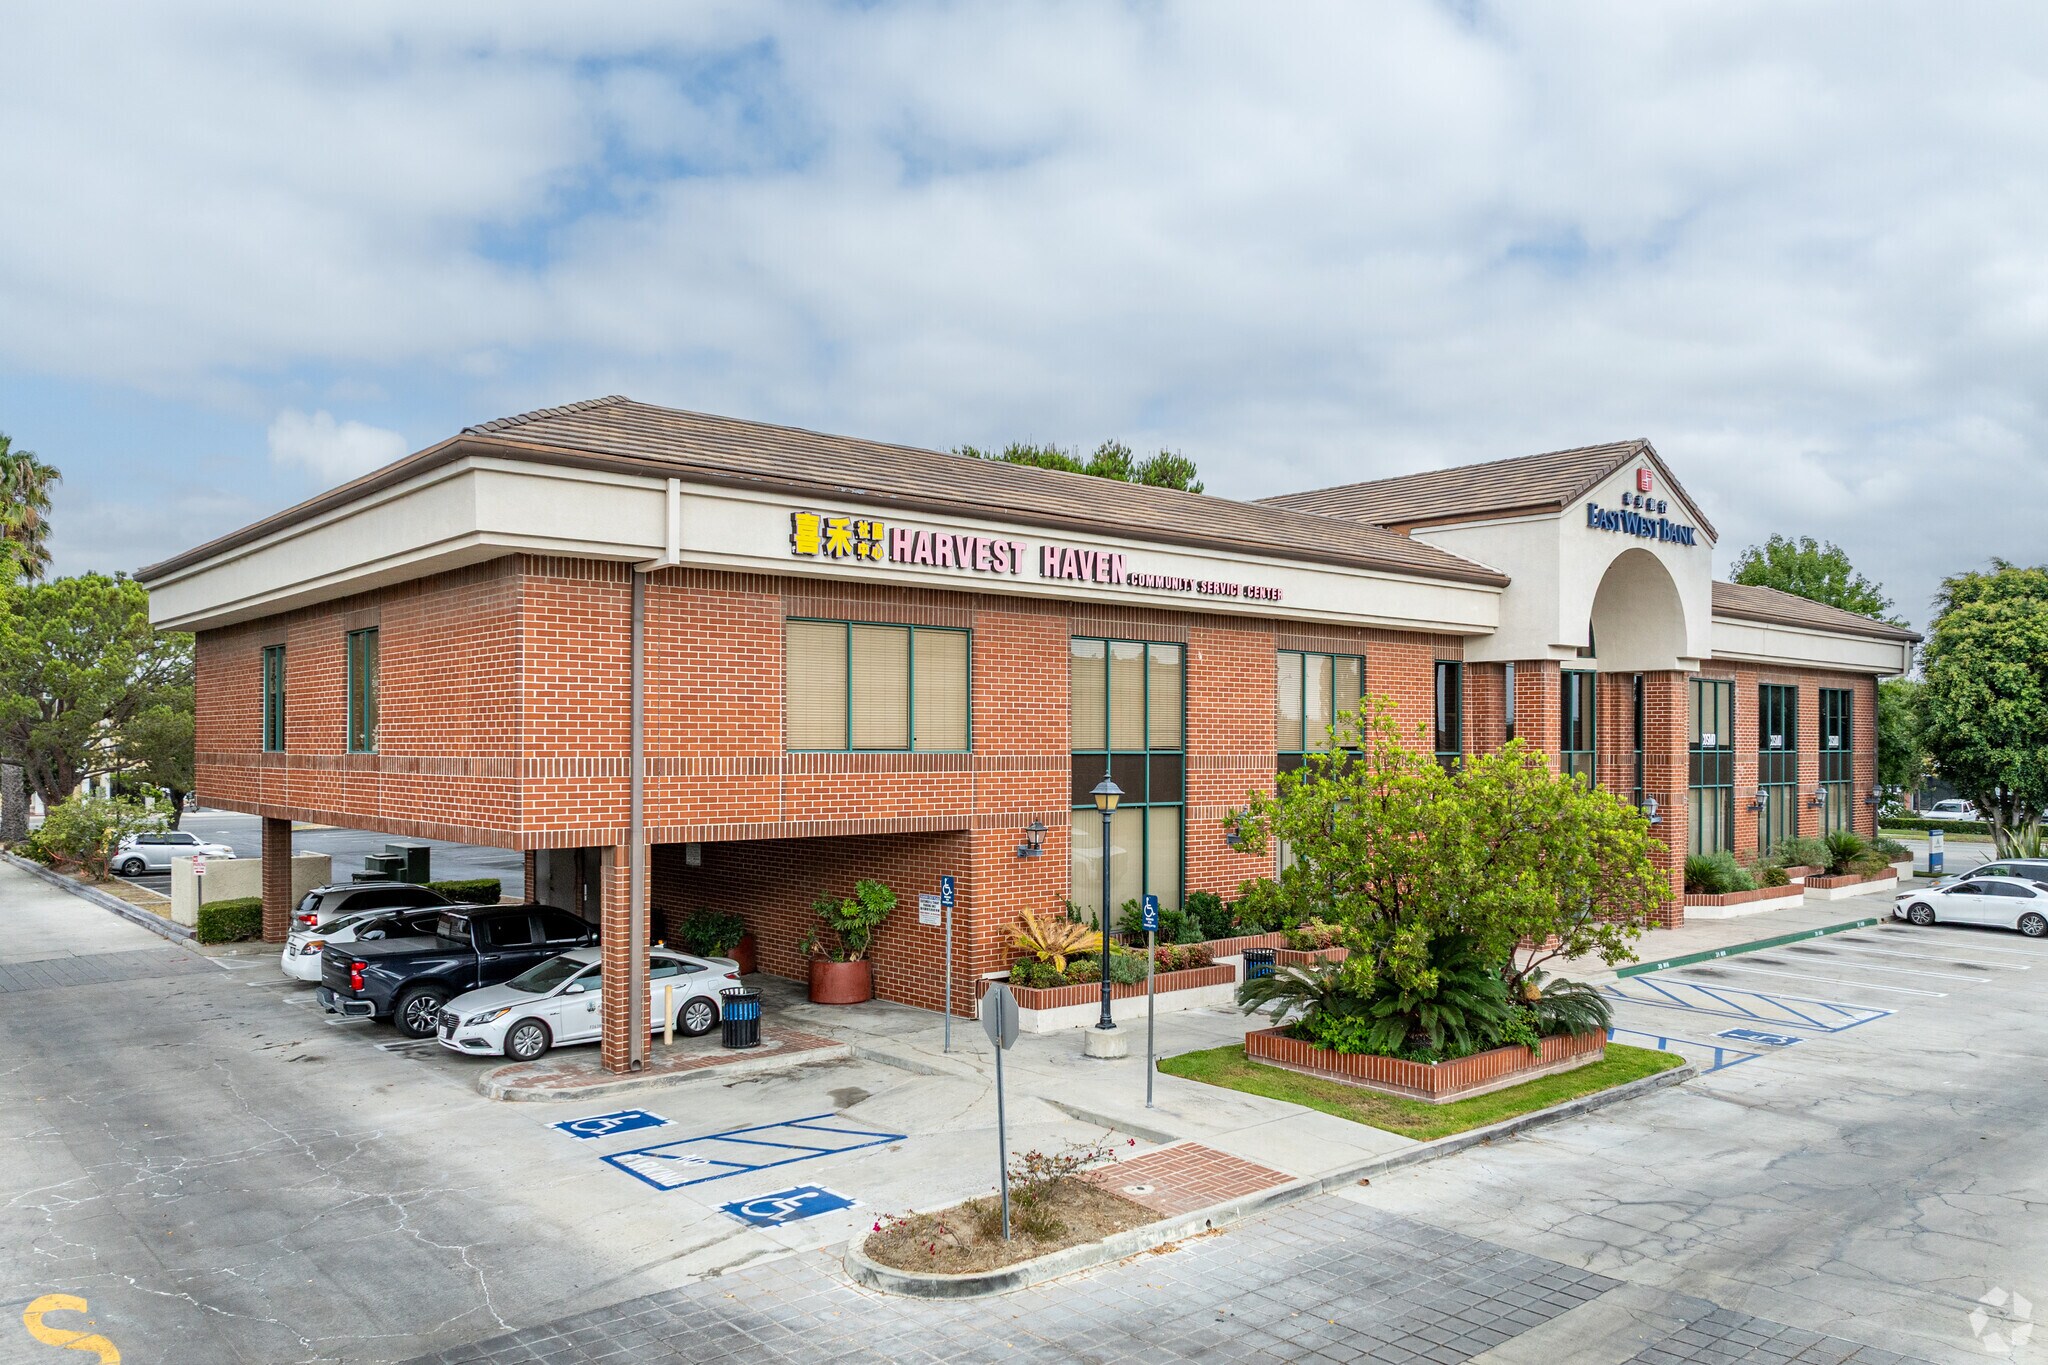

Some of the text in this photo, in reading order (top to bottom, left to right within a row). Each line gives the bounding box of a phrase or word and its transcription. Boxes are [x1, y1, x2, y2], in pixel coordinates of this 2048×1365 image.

[1658, 518, 1697, 546] BANK
[889, 528, 1127, 585] HARVEST HAVEN
[1127, 572, 1196, 592] COMMUNITY
[1243, 586, 1284, 601] CENTER
